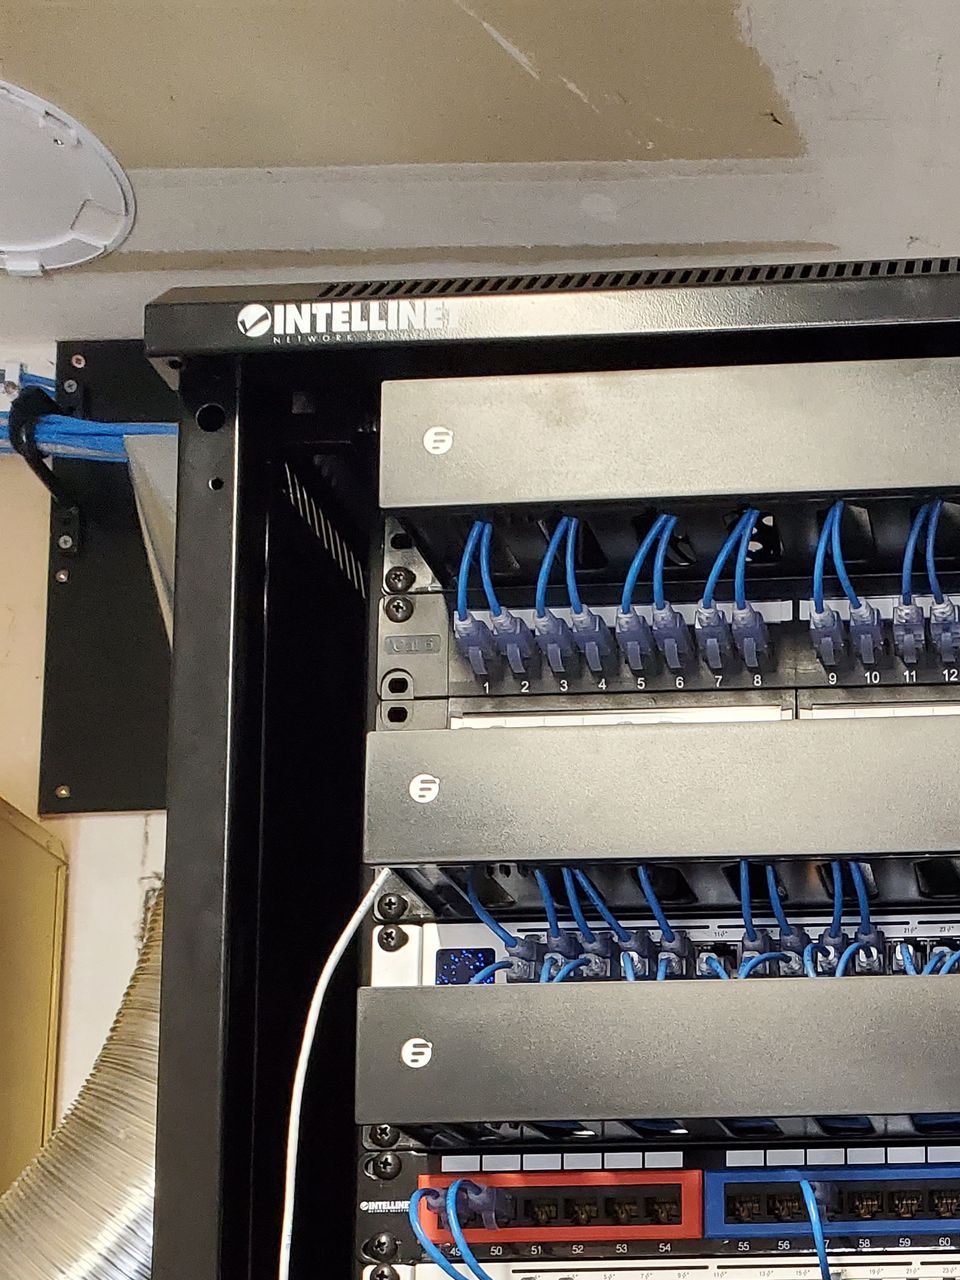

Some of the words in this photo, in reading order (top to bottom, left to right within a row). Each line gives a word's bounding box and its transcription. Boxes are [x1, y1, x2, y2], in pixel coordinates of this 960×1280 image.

[483, 682, 490, 693] 1
[521, 681, 529, 692] 2
[560, 680, 568, 691] 3
[598, 679, 607, 690] 4
[637, 678, 645, 688] 5
[676, 677, 684, 688] 6
[715, 676, 722, 687] 7
[753, 675, 762, 686] 8
[828, 673, 837, 685] 9
[865, 672, 880, 684] 10
[904, 671, 917, 682] 11
[942, 670, 958, 681] 12
[369, 1201, 411, 1210] INTELLINE
[490, 1246, 502, 1255] 50
[531, 1245, 542, 1254] 51
[572, 1244, 584, 1254] 52
[616, 1243, 627, 1253] 53
[659, 1242, 671, 1252] 54
[738, 1241, 749, 1251] 55
[778, 1240, 790, 1250] 56
[824, 1240, 830, 1248] 7
[859, 1238, 871, 1248] 58
[899, 1238, 911, 1247] 59
[939, 1237, 951, 1247] 60
